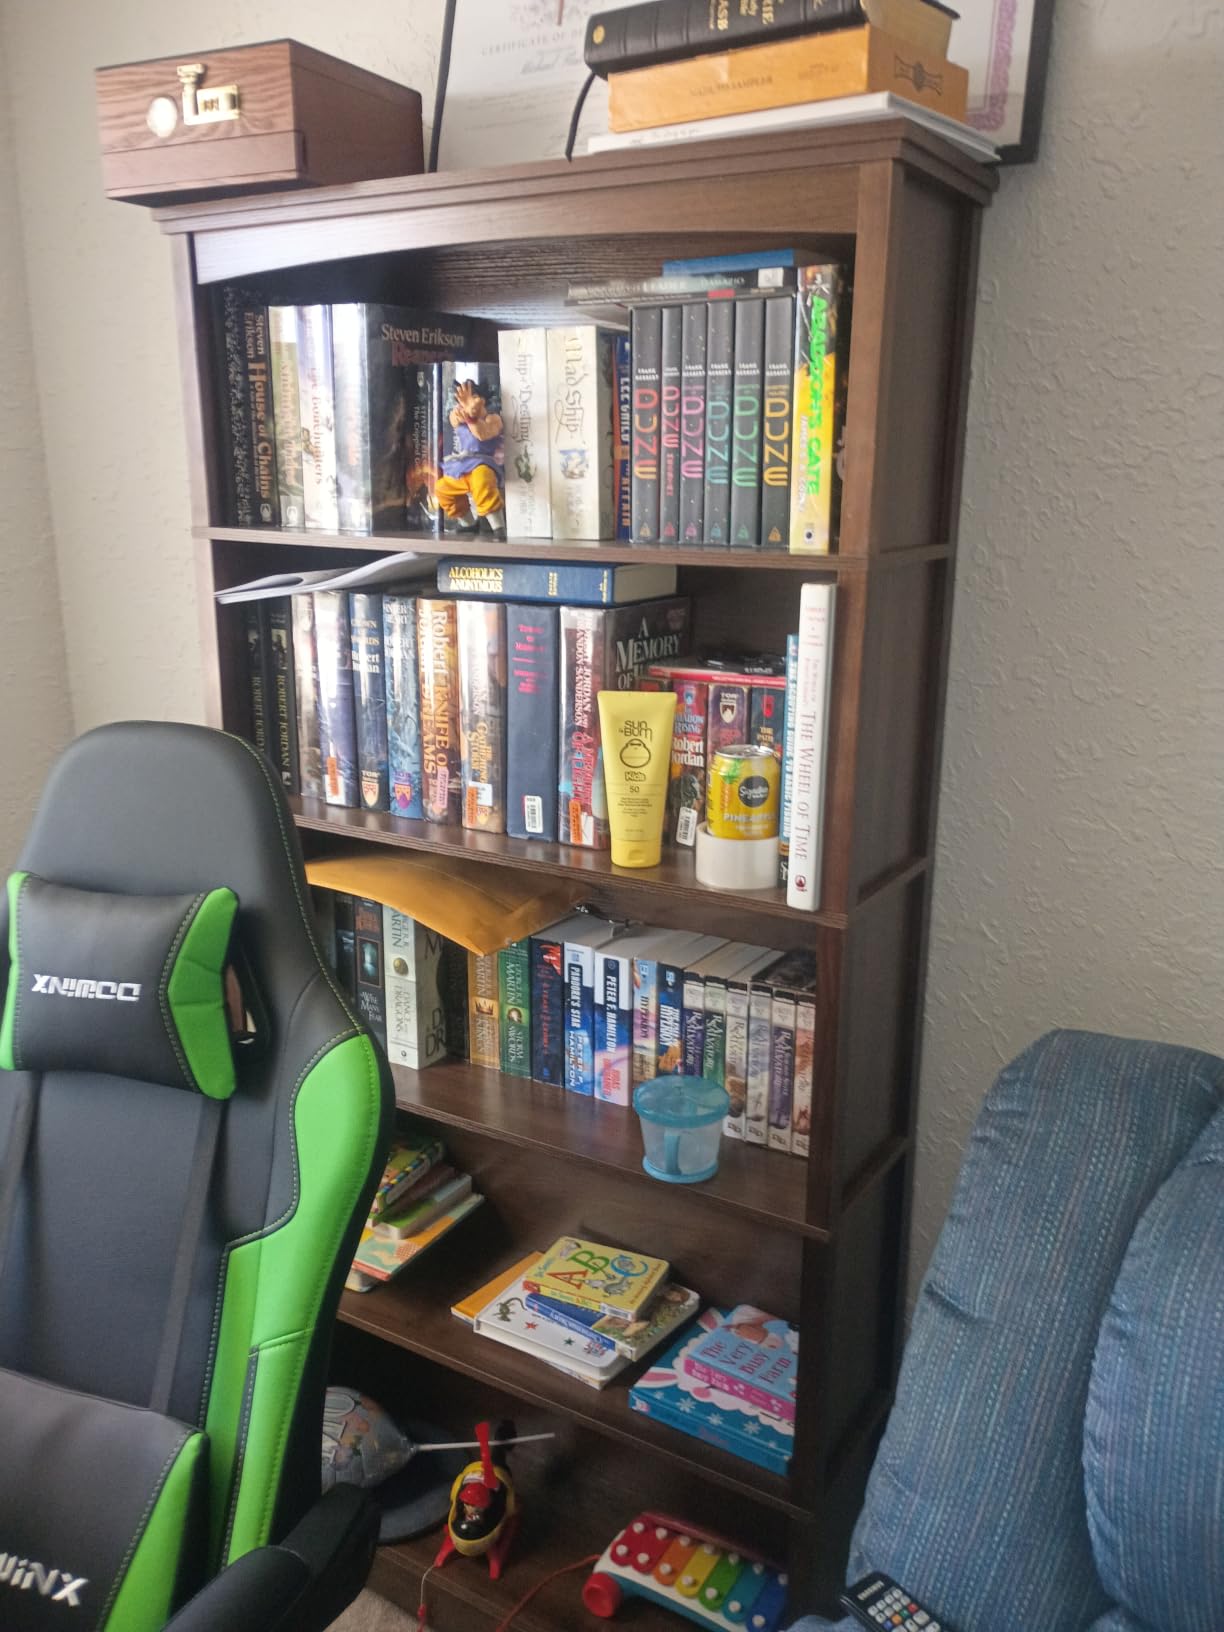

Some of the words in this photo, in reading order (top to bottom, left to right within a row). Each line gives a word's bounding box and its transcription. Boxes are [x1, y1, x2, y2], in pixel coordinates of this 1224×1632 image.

[244, 312, 255, 358] Erikson
[382, 323, 420, 344] Steven
[420, 327, 465, 347] Erikson
[808, 295, 829, 430] ABADDON'S
[248, 362, 268, 425] House
[258, 443, 273, 499] Chains
[557, 390, 584, 441] Ship
[634, 388, 658, 480] DUNE
[662, 386, 680, 448] DUNE
[681, 396, 705, 479] DUNE
[706, 401, 730, 485] DUNE
[732, 396, 759, 488] DUNE
[763, 398, 790, 487] DUNE
[807, 437, 822, 496] GATE
[449, 566, 504, 580] ALCOHOLICS
[449, 579, 503, 593] ANONYMOUS
[432, 610, 449, 674] Robert
[638, 616, 649, 639] A
[352, 651, 380, 663] Rert
[615, 634, 682, 673] MEMORY
[276, 675, 288, 717] ROBERT
[574, 666, 584, 727] SANDERSON
[583, 666, 593, 713] JORDAN
[618, 673, 633, 690] OF
[421, 682, 438, 774] DREAMS
[433, 685, 449, 749] KNIFE
[801, 711, 816, 742] THE
[279, 721, 290, 767] JORDAN
[629, 785, 640, 793] 50
[798, 747, 815, 793] WHEEL
[797, 803, 811, 819] OF
[794, 826, 811, 860] TIME
[391, 911, 403, 948] ARTIN
[506, 960, 516, 1005] MARTIN
[570, 965, 581, 1008] PANDORA'S
[606, 974, 617, 1003] PETER
[570, 1009, 581, 1029] STAR
[606, 1011, 617, 1053] HAMILTON
[639, 995, 649, 1039] HYPERION
[659, 1004, 671, 1046] HYPERION
[568, 1030, 576, 1087] HAMILTON
[701, 1340, 726, 1359] The
[719, 1341, 753, 1366] Very
[739, 1351, 769, 1376] Busy
[757, 1356, 792, 1384] Farm
